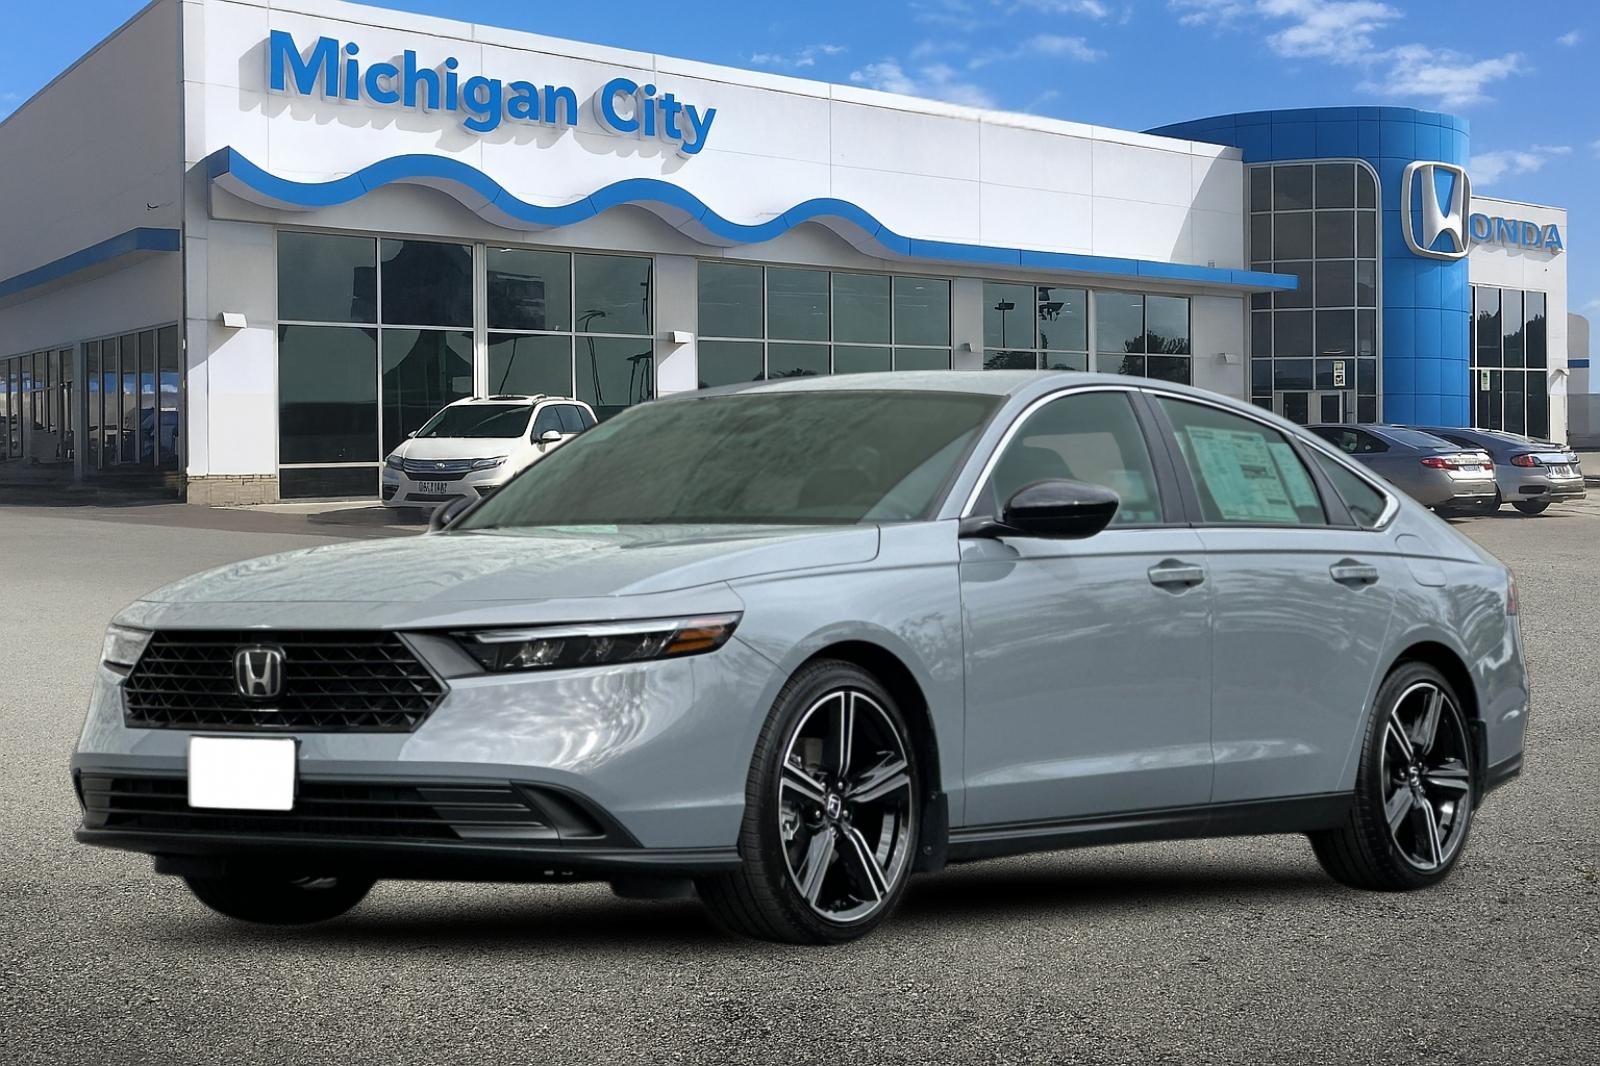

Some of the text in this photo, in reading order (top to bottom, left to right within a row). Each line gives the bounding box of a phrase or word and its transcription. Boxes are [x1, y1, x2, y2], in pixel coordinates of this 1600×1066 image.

[269, 29, 717, 155] Michigan City
[1469, 212, 1564, 250] ONDA
